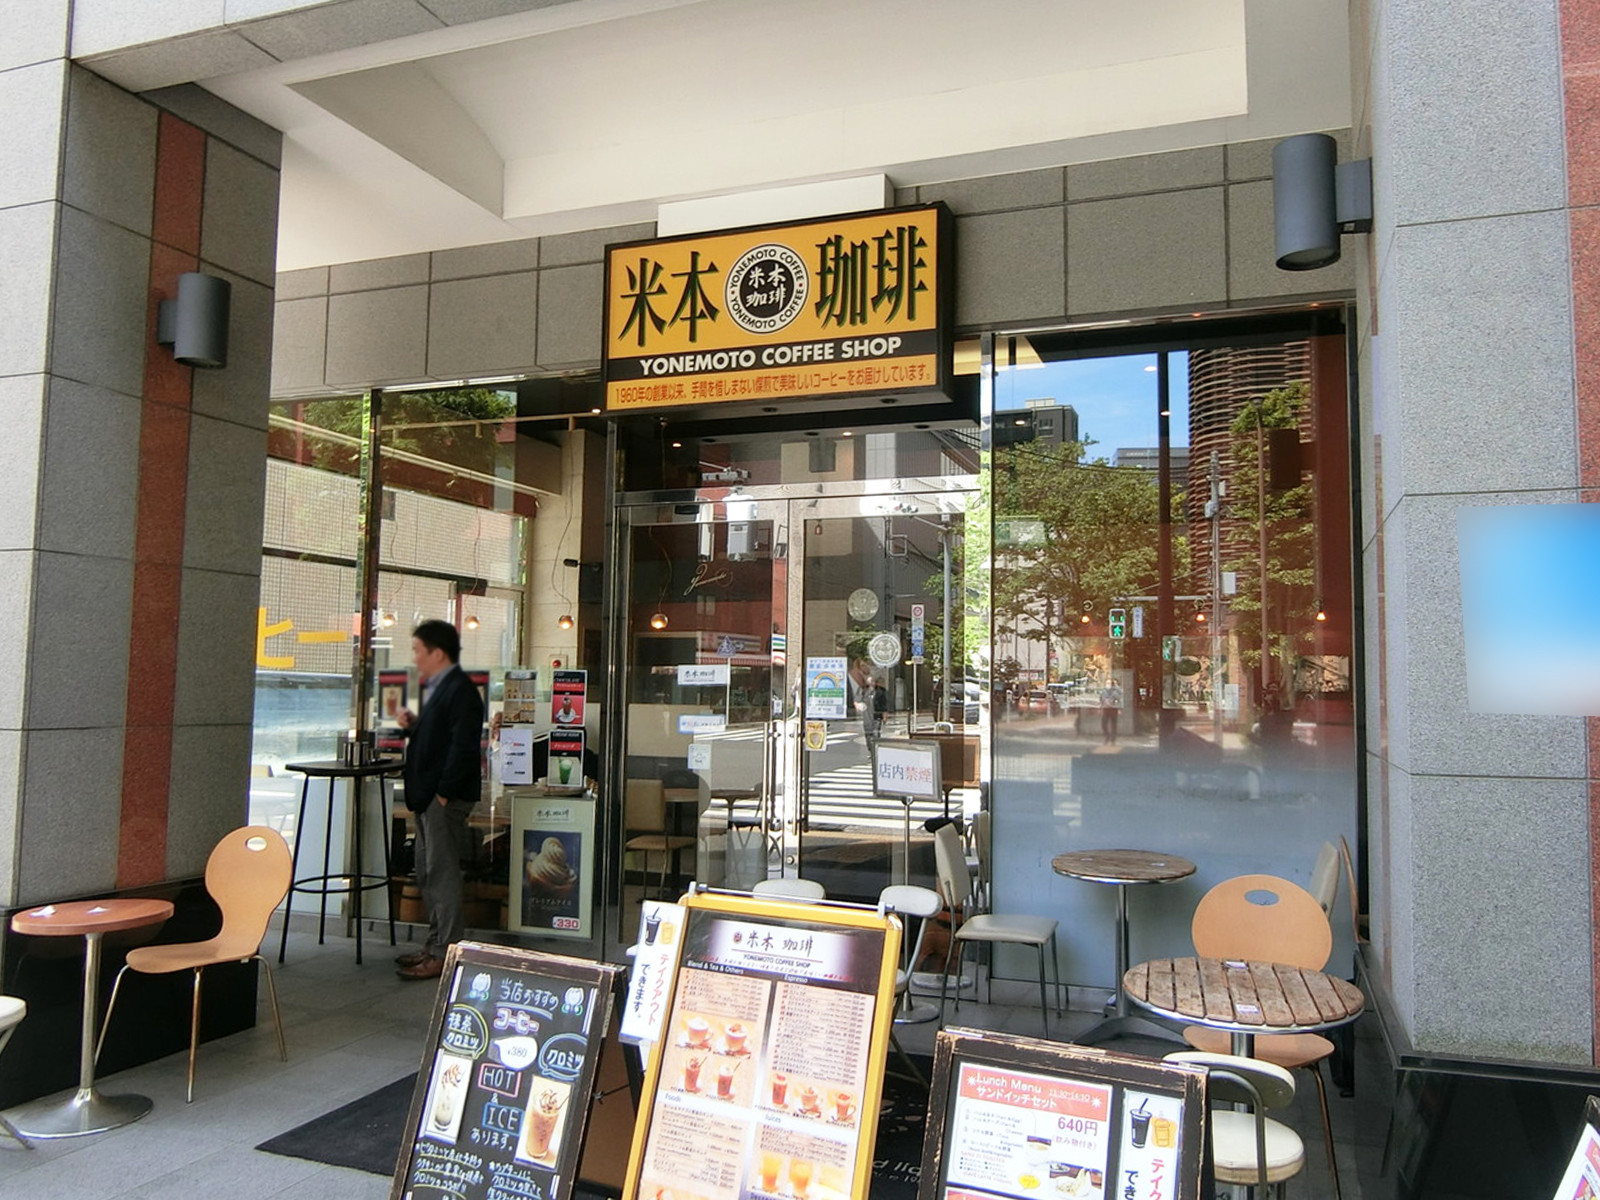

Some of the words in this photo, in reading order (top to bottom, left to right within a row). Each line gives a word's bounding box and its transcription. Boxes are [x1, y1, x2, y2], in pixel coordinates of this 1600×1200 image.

[730, 249, 777, 289] YONEMOTO
[780, 252, 804, 281] COFFEE
[748, 263, 787, 288] 米本
[617, 250, 720, 348] 米本
[814, 225, 929, 330] 珈琲
[746, 283, 787, 311] 珈琲
[730, 296, 777, 329] YONEMOTO
[779, 289, 804, 322] COFFEE
[639, 350, 756, 376] YONEMOTO
[762, 342, 834, 366] COFFEE
[841, 336, 902, 359] SHOP
[878, 761, 933, 783] 店内禁煙
[746, 929, 774, 952] 米本
[782, 935, 814, 957] 珈琲
[743, 954, 774, 964] YONEMOTO
[775, 957, 794, 967] COFFEE
[795, 960, 812, 968] SHOP
[648, 954, 669, 1026] テイクアウト
[784, 973, 809, 983] Espresso
[493, 1008, 539, 1035] コーヒー
[484, 1069, 515, 1090] HOT
[976, 1072, 1008, 1087] Lunch
[1010, 1078, 1042, 1094] Menu
[977, 1085, 1057, 1109] サンドイッチセット
[487, 1107, 520, 1130] ICE
[1058, 1117, 1098, 1137] 640円
